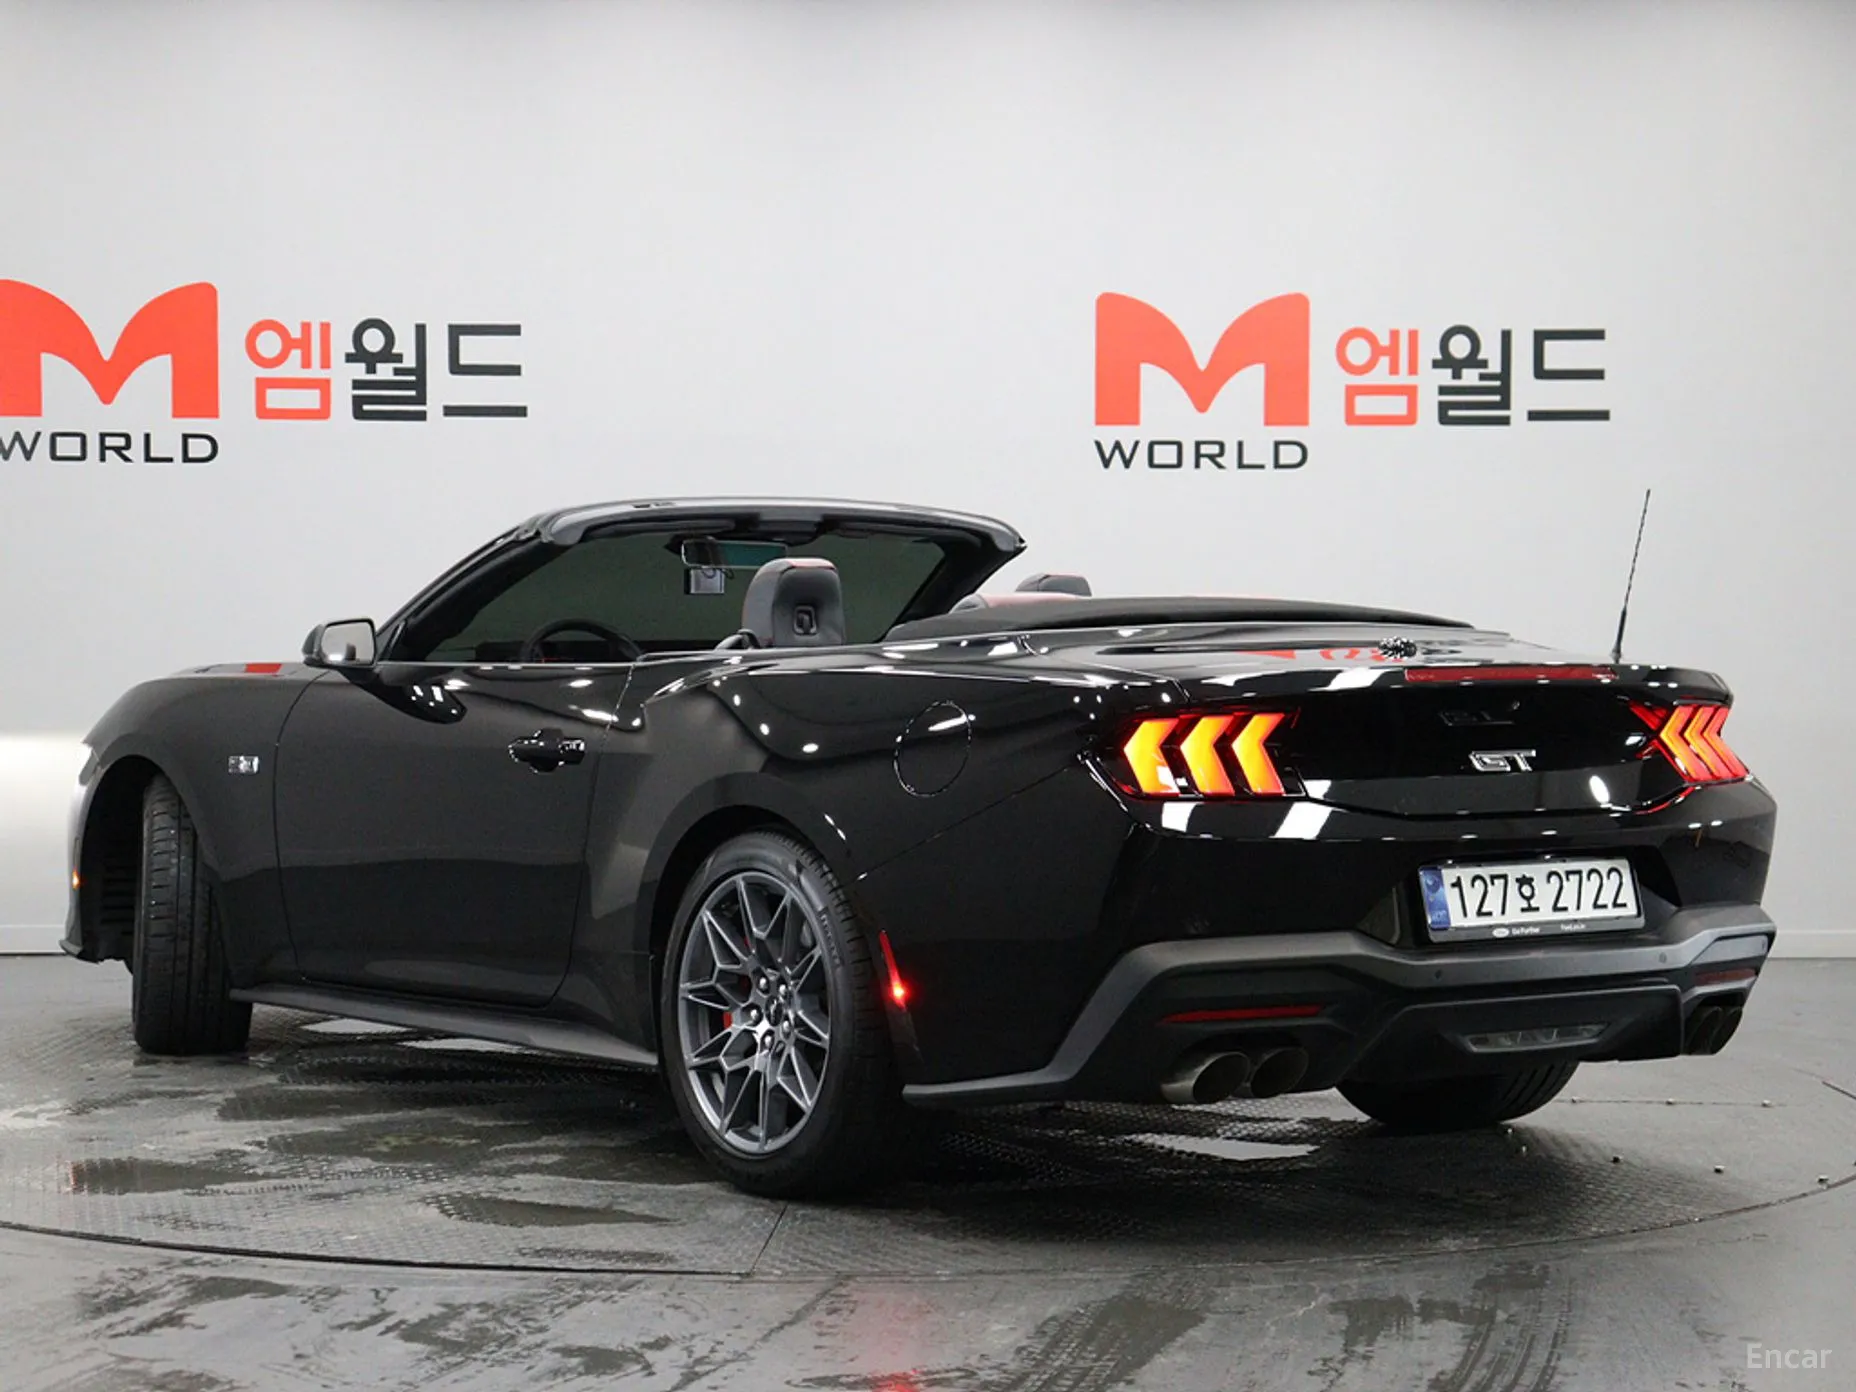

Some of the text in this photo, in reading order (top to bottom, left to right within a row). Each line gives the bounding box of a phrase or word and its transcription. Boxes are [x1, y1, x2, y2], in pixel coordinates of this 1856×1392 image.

[0, 279, 219, 418] M
[245, 317, 528, 421] 엠월드
[1095, 292, 1310, 426] M
[1335, 324, 1610, 426] 엠월드
[0, 431, 219, 463] WORLD
[1094, 439, 1308, 470] WORLD
[1468, 750, 1536, 771] GT
[1450, 867, 1627, 918] 127호 2722
